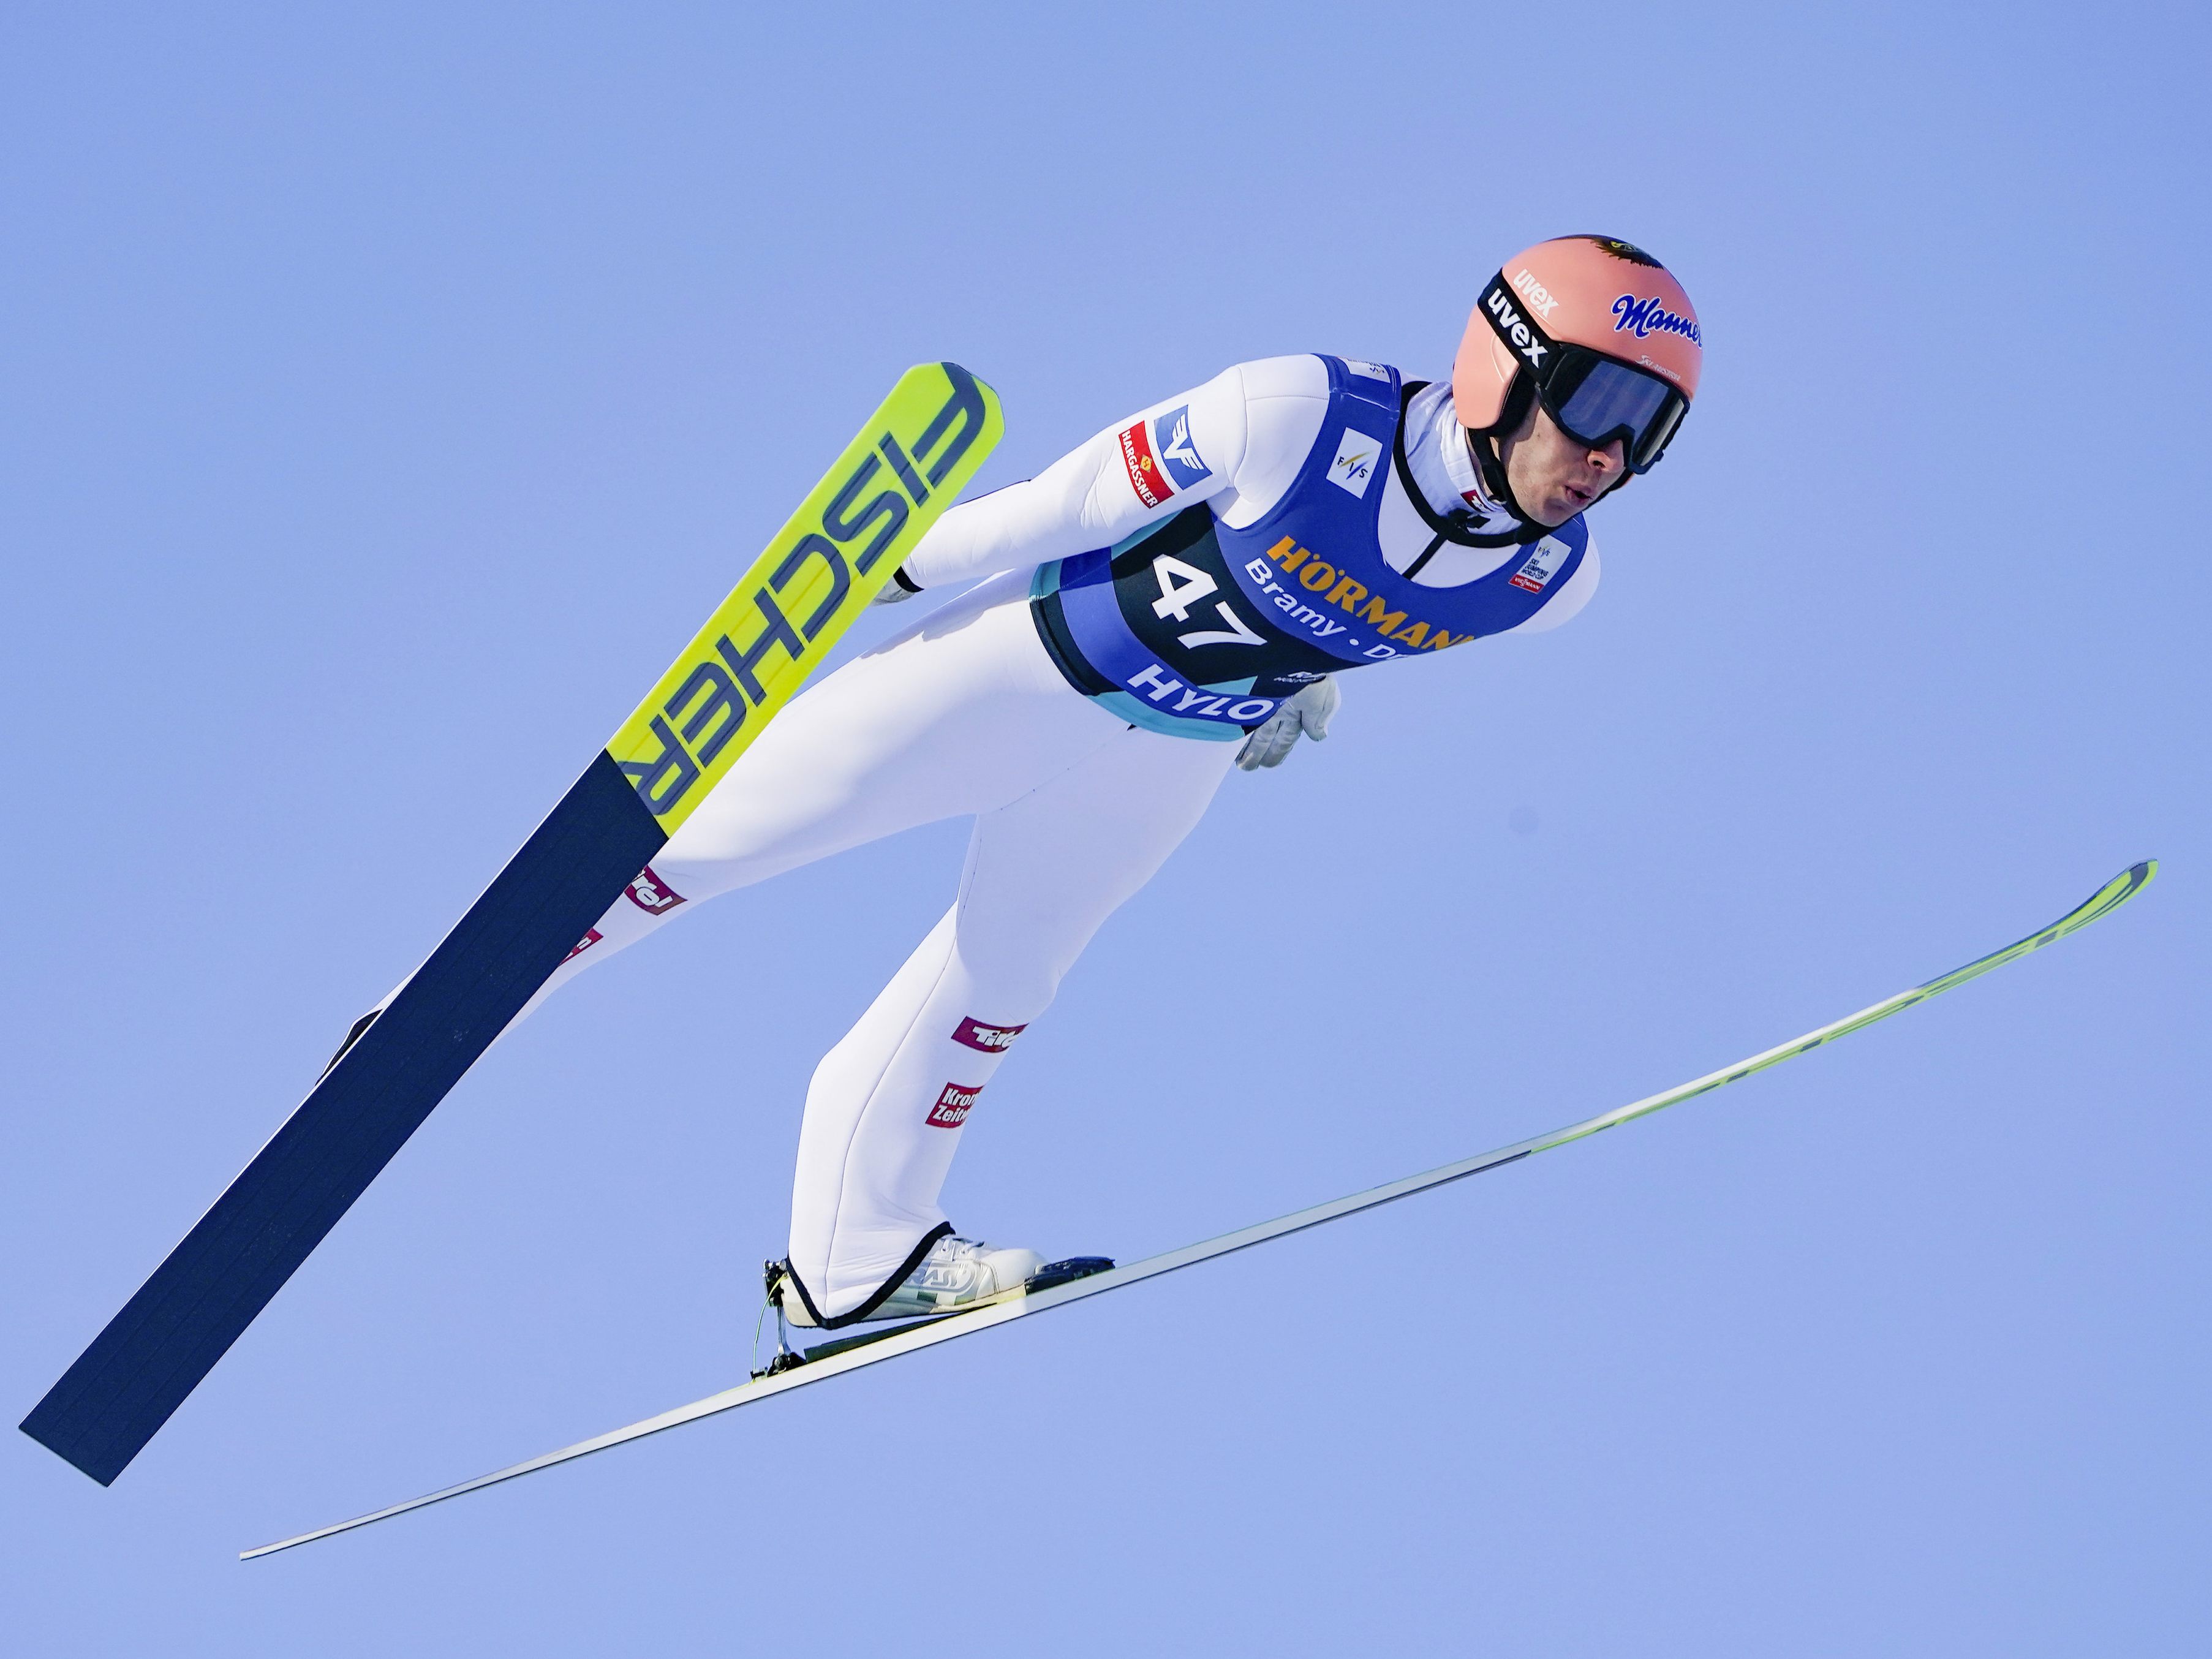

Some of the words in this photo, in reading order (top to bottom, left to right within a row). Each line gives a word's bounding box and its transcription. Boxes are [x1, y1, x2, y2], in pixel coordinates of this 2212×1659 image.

[1488, 288, 1549, 369] uvex
[1513, 268, 1559, 317] uvex
[1122, 429, 1158, 507] HARGASSNER
[617, 361, 986, 816] FISCHER
[1152, 553, 1267, 649] 47
[1244, 557, 1348, 637] Bramy
